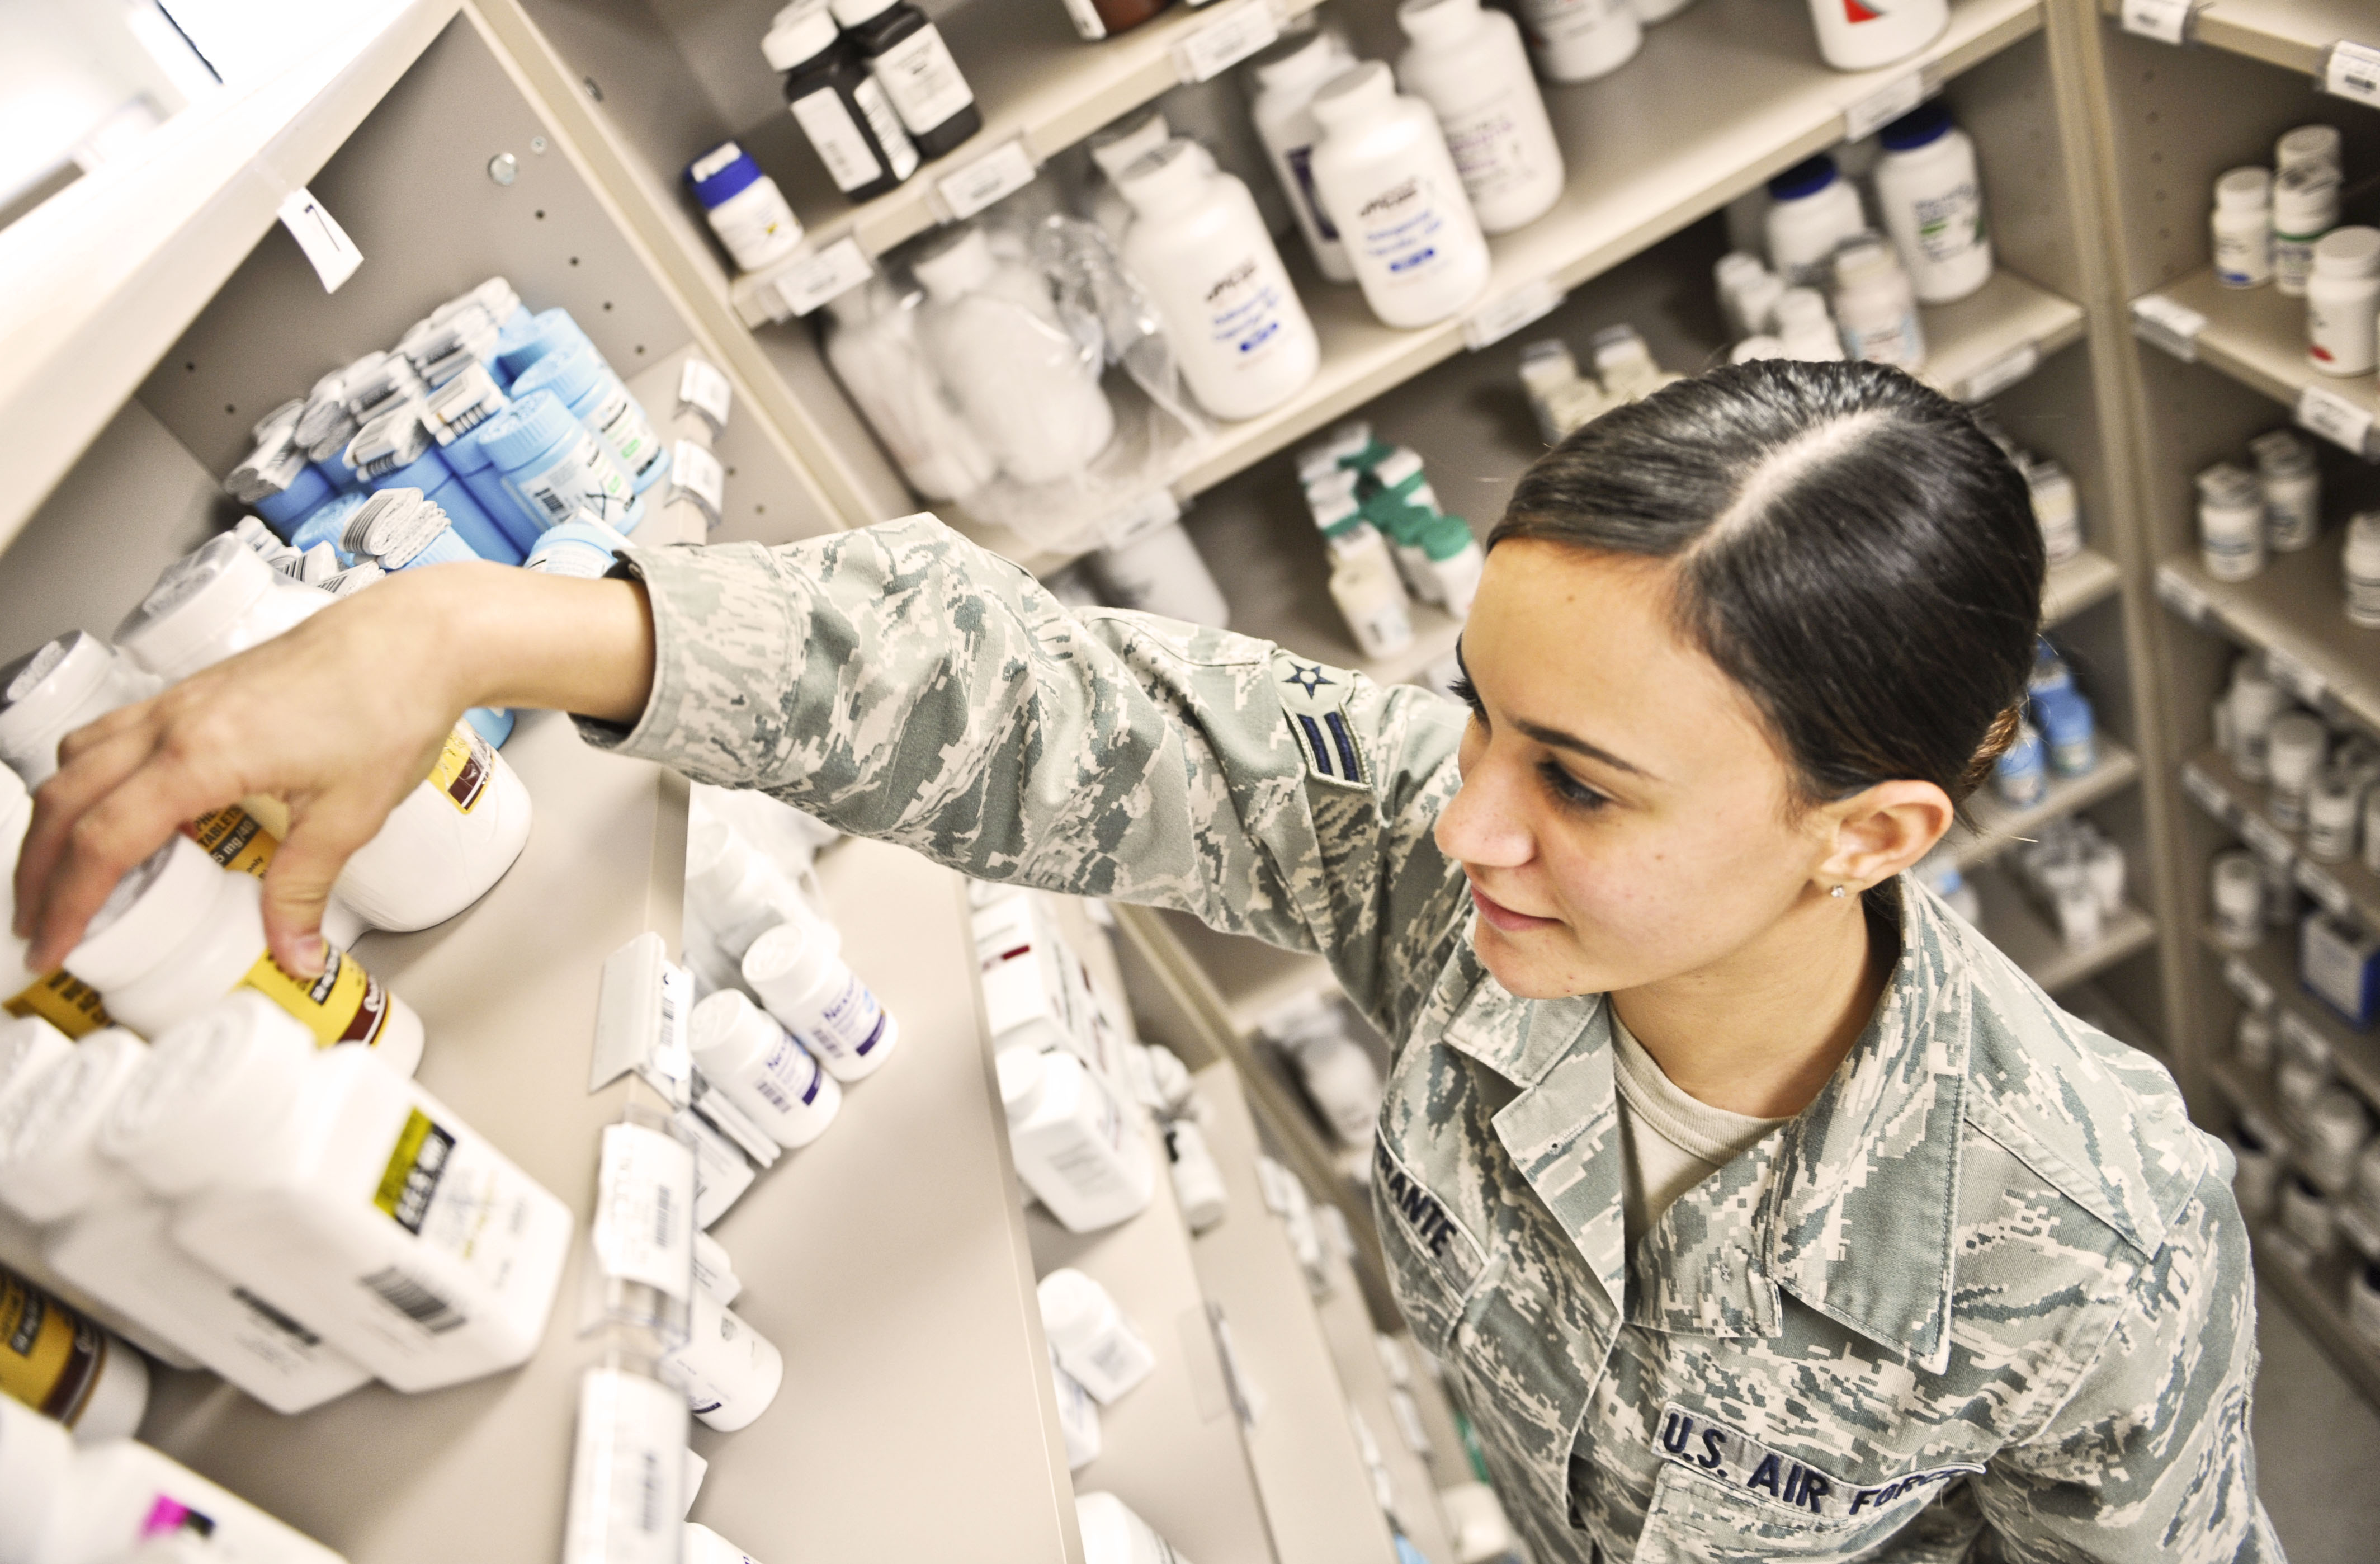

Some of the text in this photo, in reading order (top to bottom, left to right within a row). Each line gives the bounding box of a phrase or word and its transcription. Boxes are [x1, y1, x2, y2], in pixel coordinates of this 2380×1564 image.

[194, 810, 219, 832] PHE
[197, 804, 242, 848] TABLETS
[1376, 1133, 1457, 1257] RANTE
[1663, 1412, 1728, 1478] U.S.
[1747, 1453, 1829, 1513] AIR
